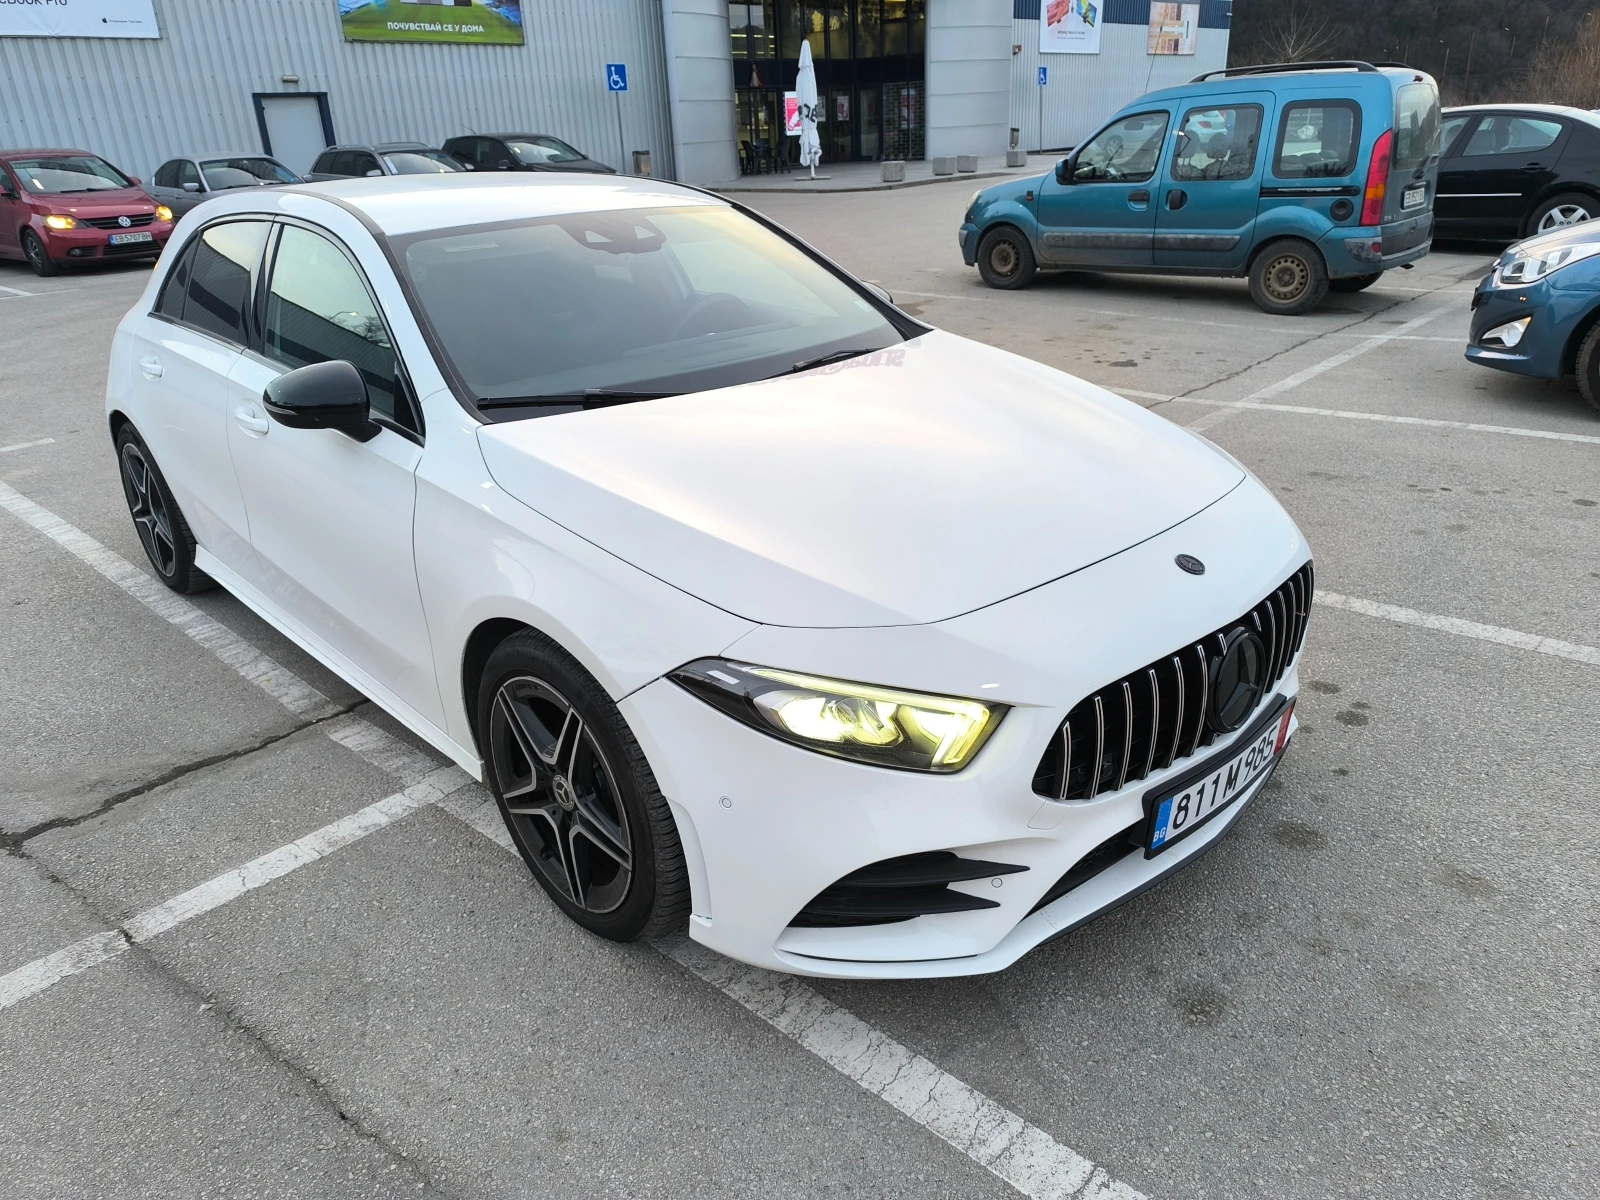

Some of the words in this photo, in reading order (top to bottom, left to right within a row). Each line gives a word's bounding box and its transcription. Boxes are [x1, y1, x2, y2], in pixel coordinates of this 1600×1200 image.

[387, 22, 441, 32] ПОЧУВСТВАЙ
[443, 24, 453, 32] СЕ
[454, 24, 460, 32] У
[462, 25, 485, 33] ДОМА
[125, 233, 140, 241] 5707
[1153, 826, 1167, 843] BG
